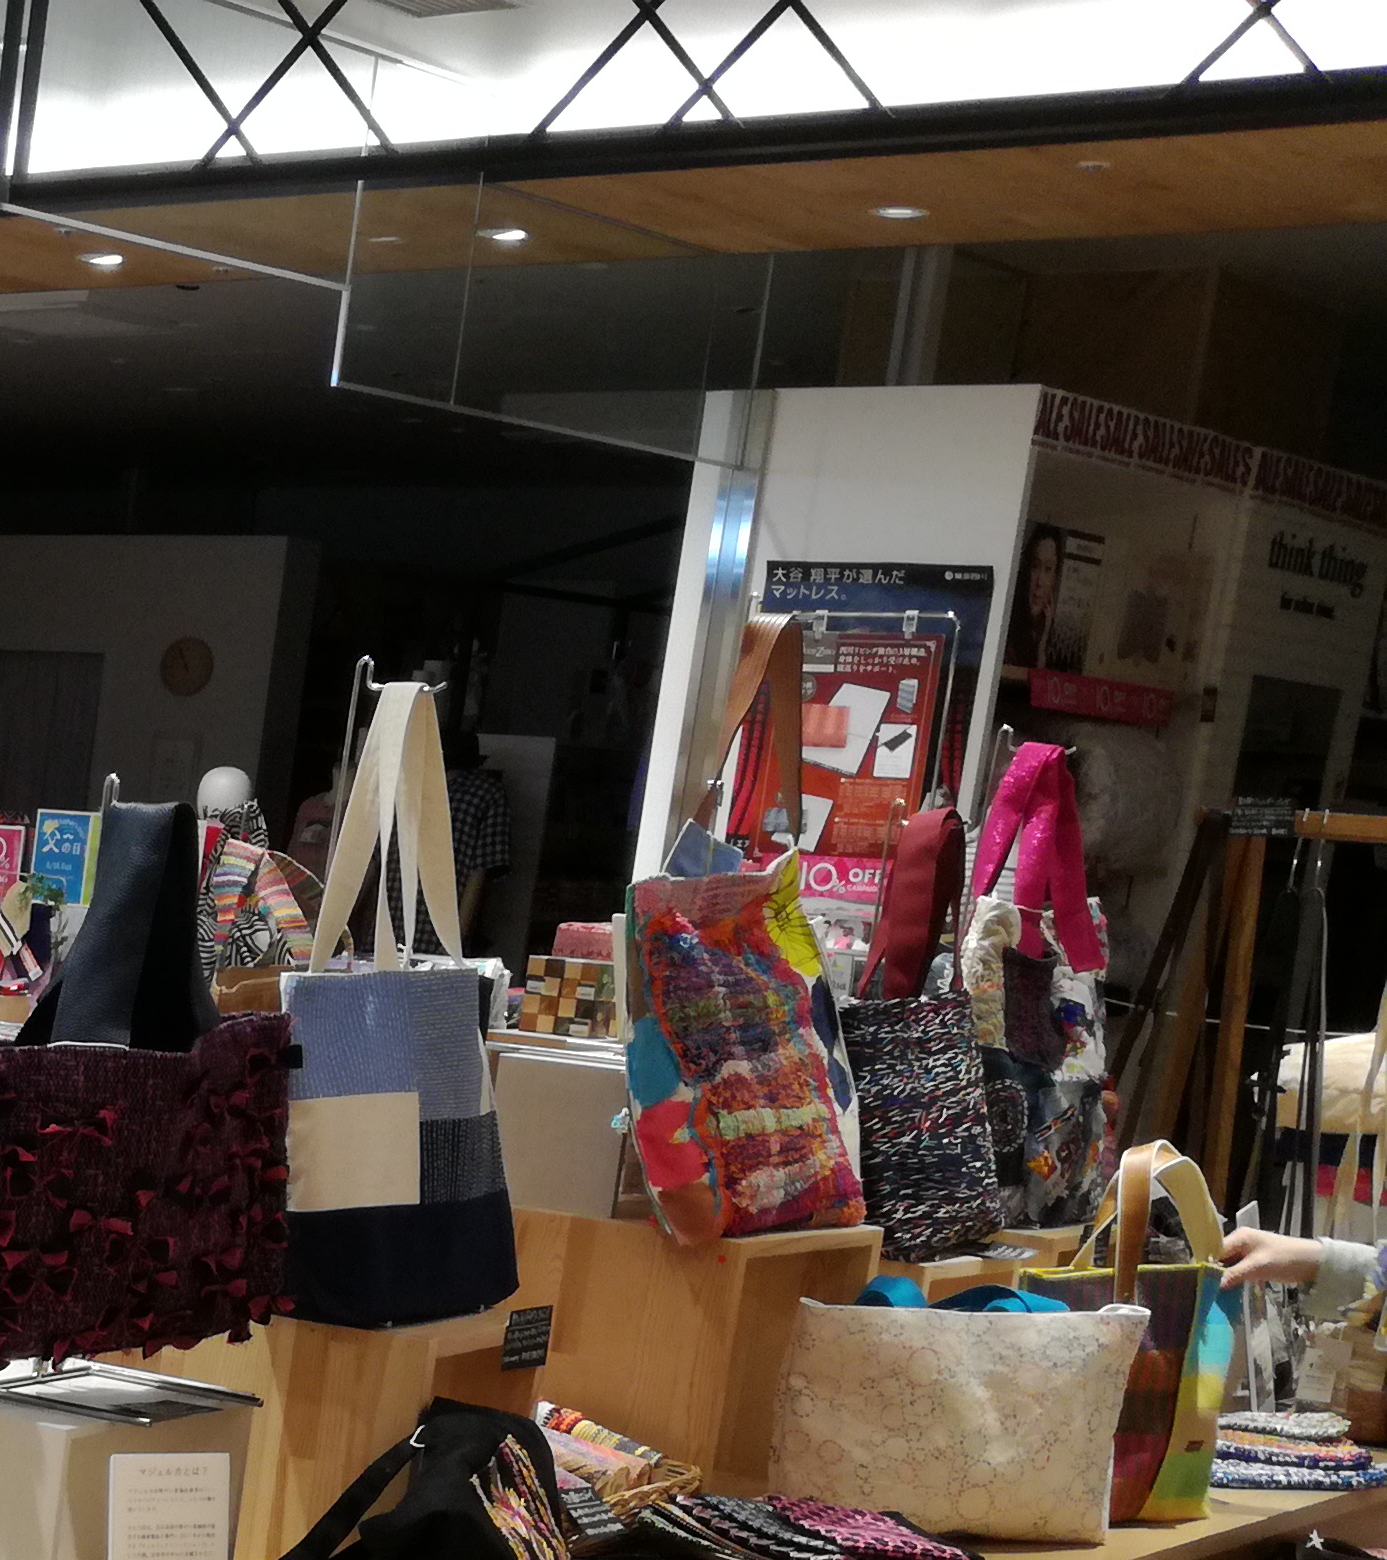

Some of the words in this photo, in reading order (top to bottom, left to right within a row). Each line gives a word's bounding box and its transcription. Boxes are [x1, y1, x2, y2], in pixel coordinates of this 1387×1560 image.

[772, 567, 803, 583] 大谷
[810, 567, 906, 585] 翔平が選んだ
[771, 585, 847, 600] マットレス。
